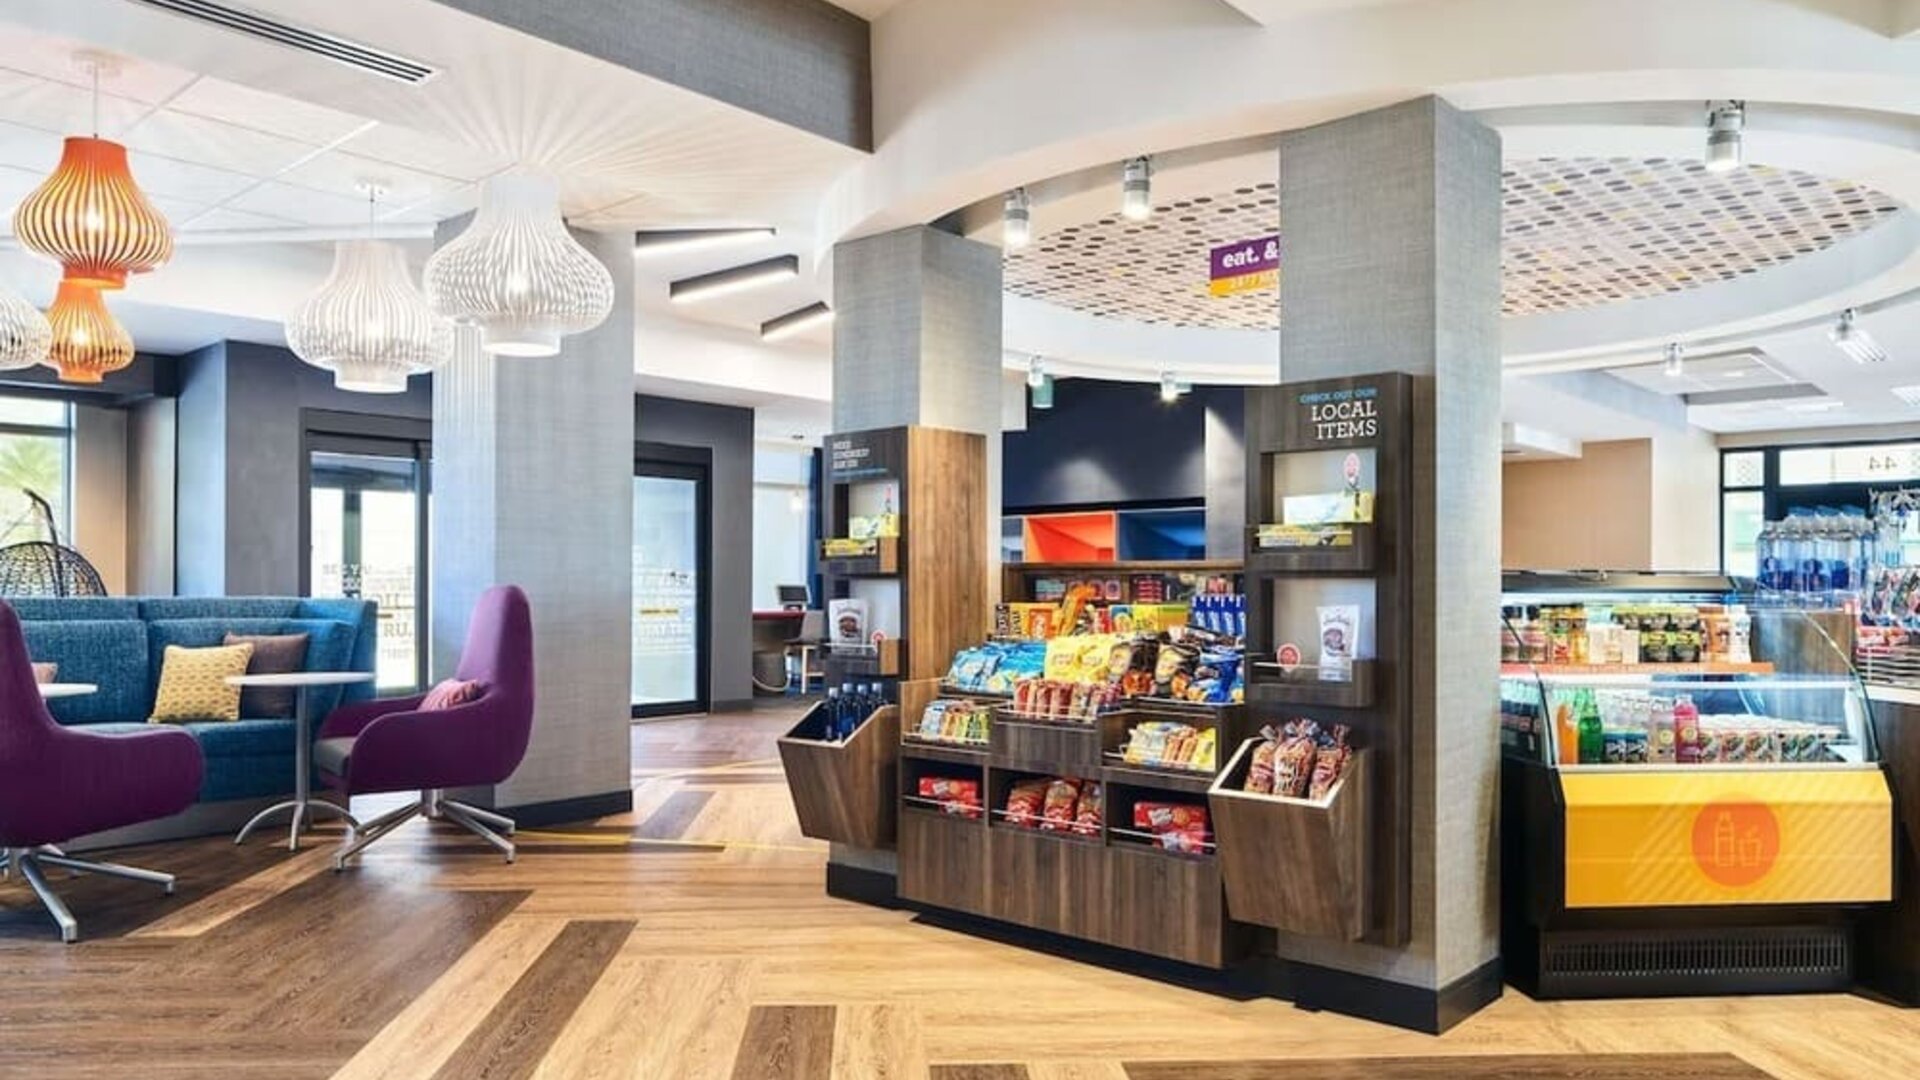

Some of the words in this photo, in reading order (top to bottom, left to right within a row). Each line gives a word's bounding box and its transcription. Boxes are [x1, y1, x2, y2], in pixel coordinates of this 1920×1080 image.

[1222, 246, 1259, 268] eat.
[1264, 241, 1279, 260] &
[1300, 392, 1329, 403] CHECK
[1333, 390, 1352, 400] OUT
[1312, 401, 1377, 421] LOCAL
[1316, 419, 1377, 440] ITEMS
